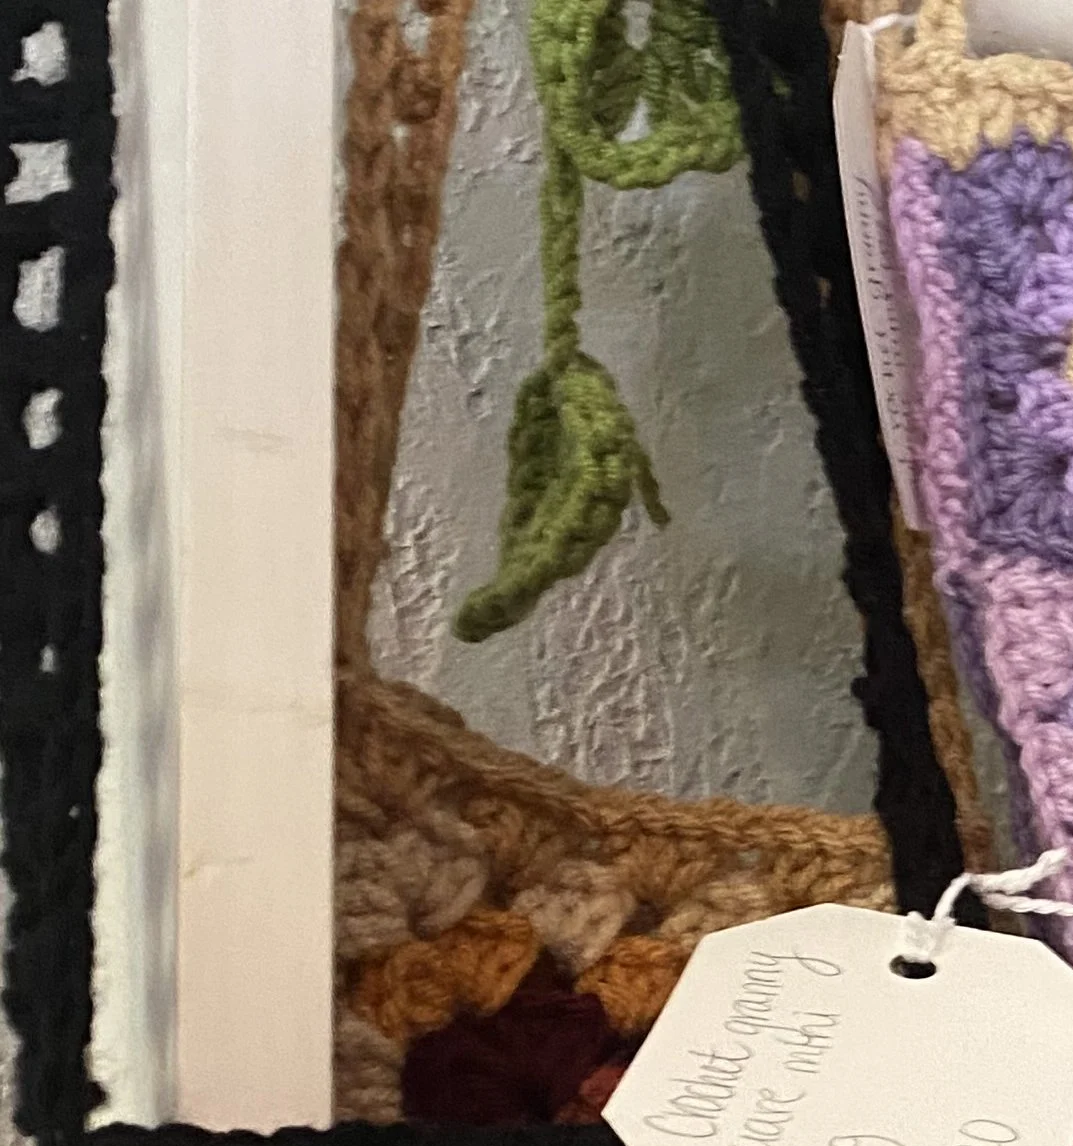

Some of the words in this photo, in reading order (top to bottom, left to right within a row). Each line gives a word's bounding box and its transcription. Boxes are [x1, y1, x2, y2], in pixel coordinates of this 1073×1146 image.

[644, 1043, 754, 1138] Crochet
[724, 951, 841, 1045] granny
[782, 1010, 841, 1074] mini
